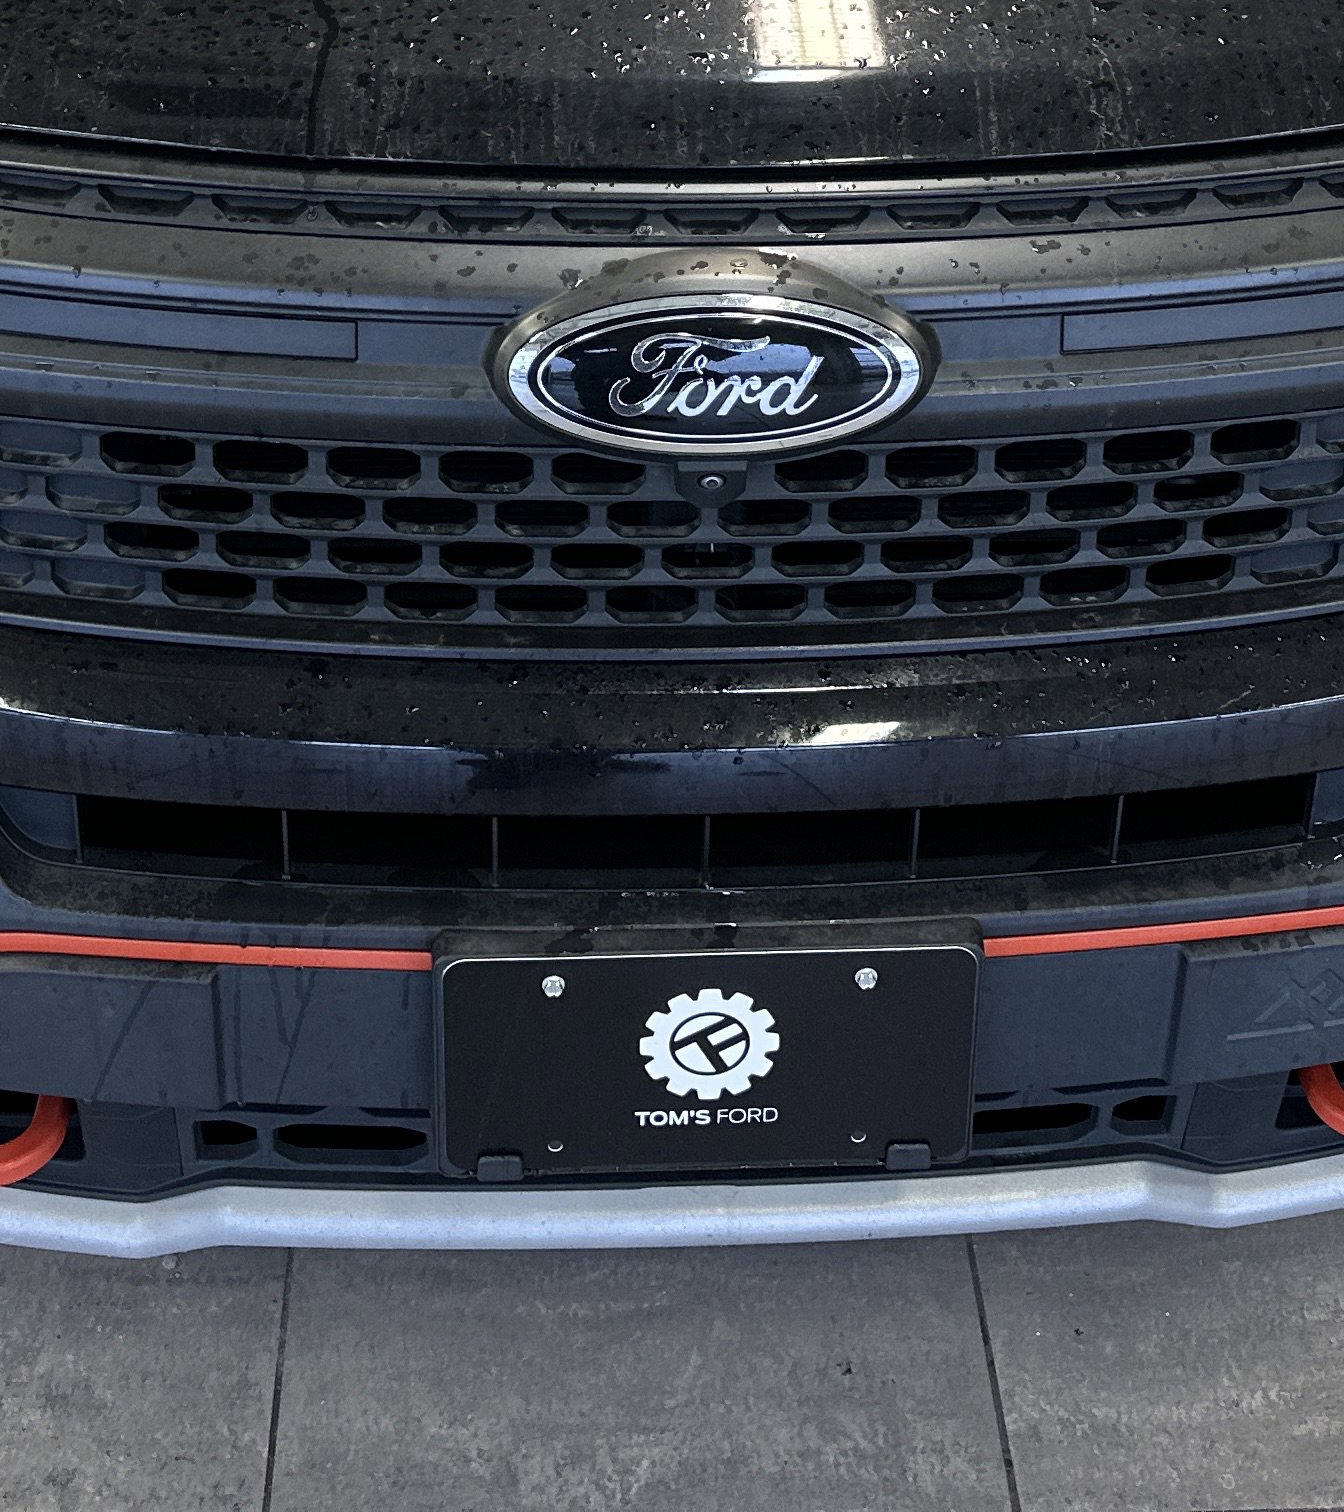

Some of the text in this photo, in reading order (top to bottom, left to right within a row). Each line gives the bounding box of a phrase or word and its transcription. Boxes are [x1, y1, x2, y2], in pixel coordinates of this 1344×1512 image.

[609, 332, 825, 417] Ford
[634, 1107, 779, 1127] TOM'S FORD
